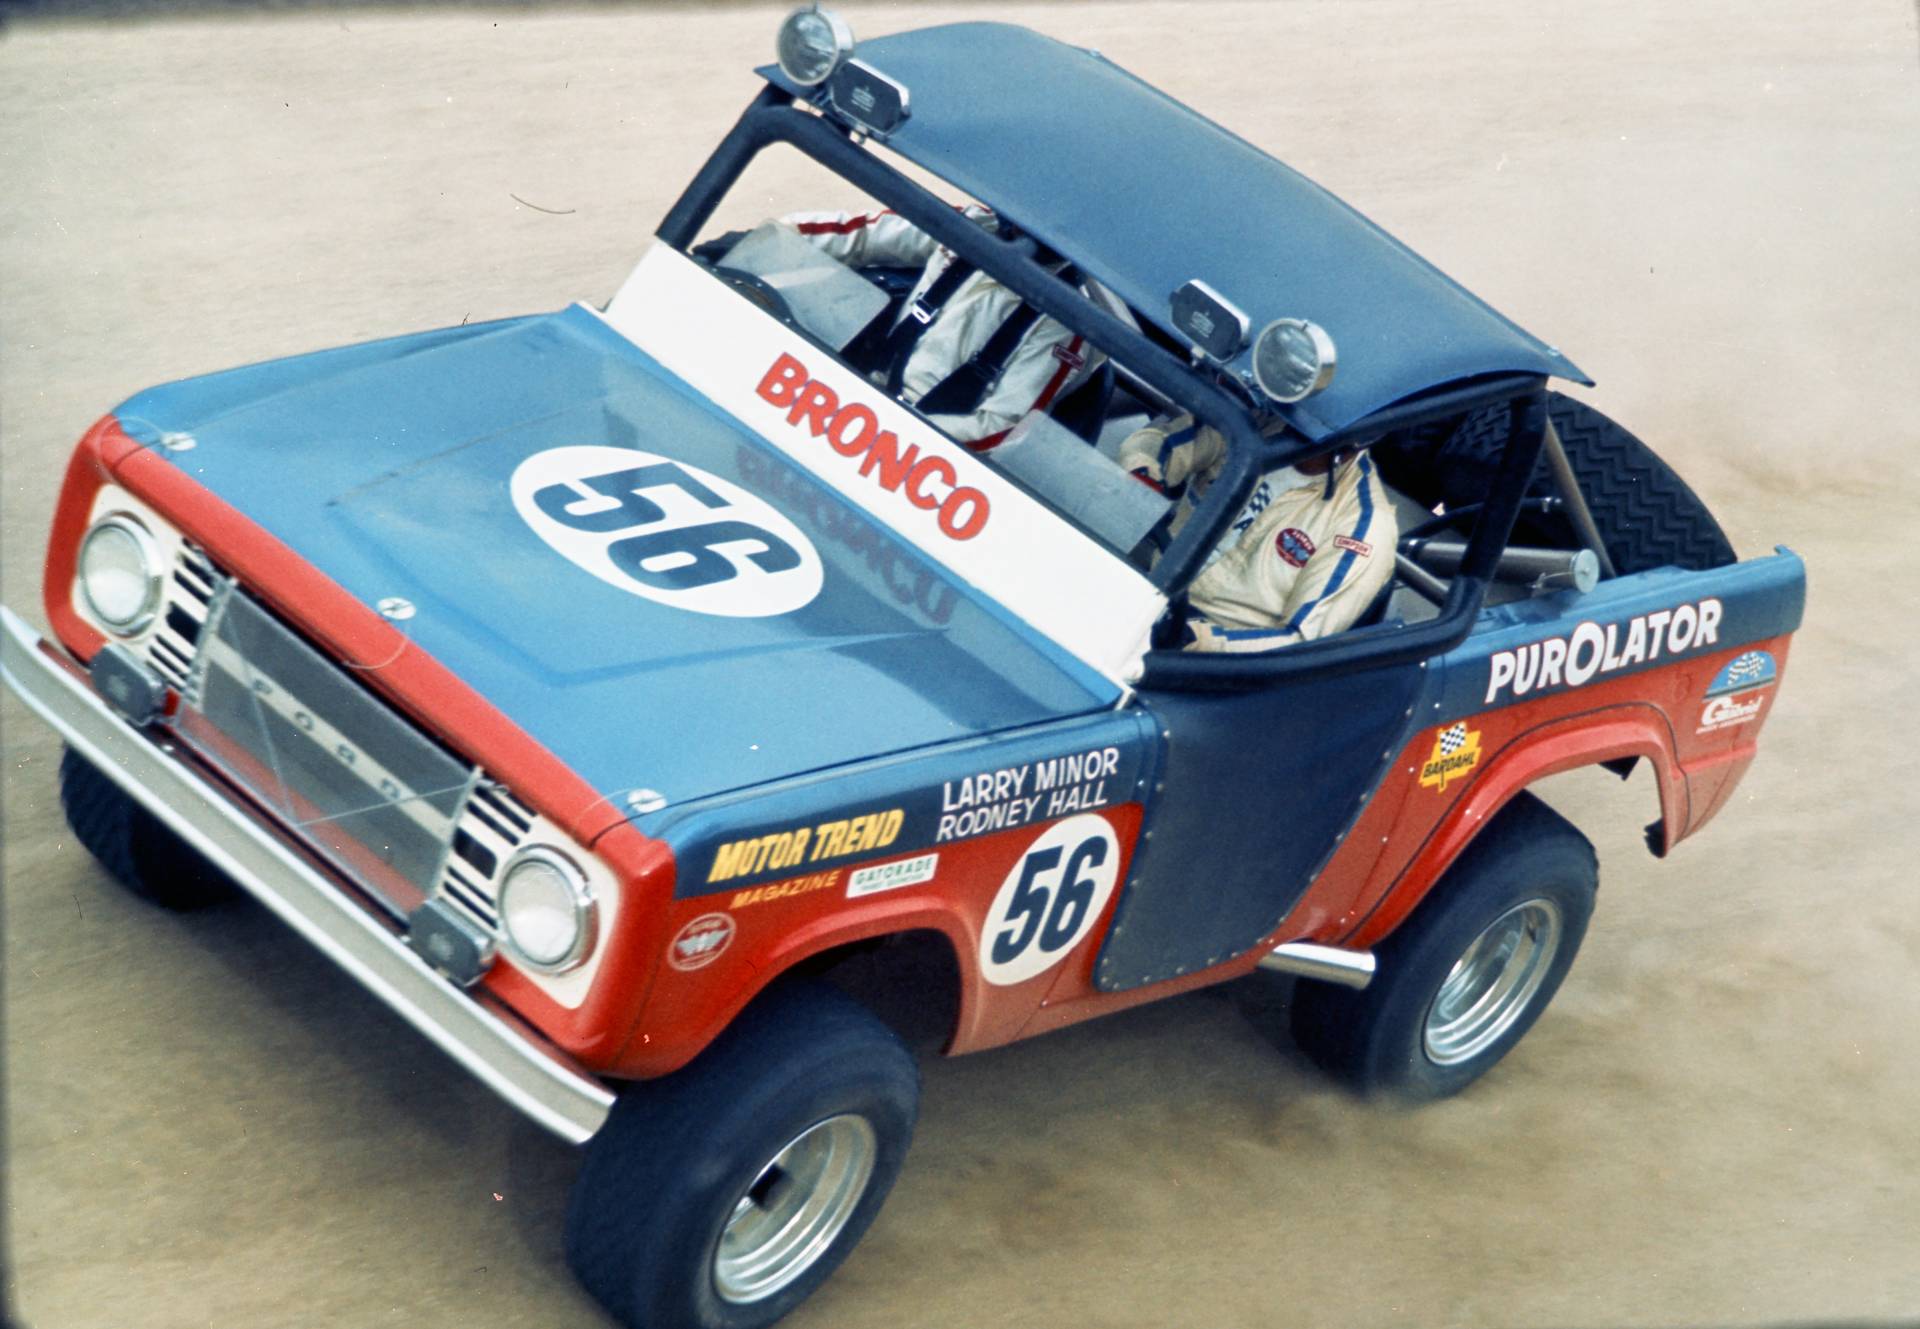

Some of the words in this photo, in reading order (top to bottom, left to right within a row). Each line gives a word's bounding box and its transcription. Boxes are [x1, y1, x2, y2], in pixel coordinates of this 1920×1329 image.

[756, 352, 990, 541] BRONCO
[532, 461, 802, 591] 56
[1484, 597, 1723, 704] PUROLATOR
[943, 765, 1029, 812] LARRY
[1035, 747, 1119, 791] MINOR
[1422, 751, 1475, 778] BARDAHL
[707, 828, 811, 883] MOTOR
[810, 809, 904, 861] TREND
[936, 795, 1041, 842] RODNEY
[1047, 781, 1107, 817] HALL
[729, 870, 842, 909] MAGAZINE
[855, 856, 933, 885] GATORADE
[991, 835, 1109, 965] 56
